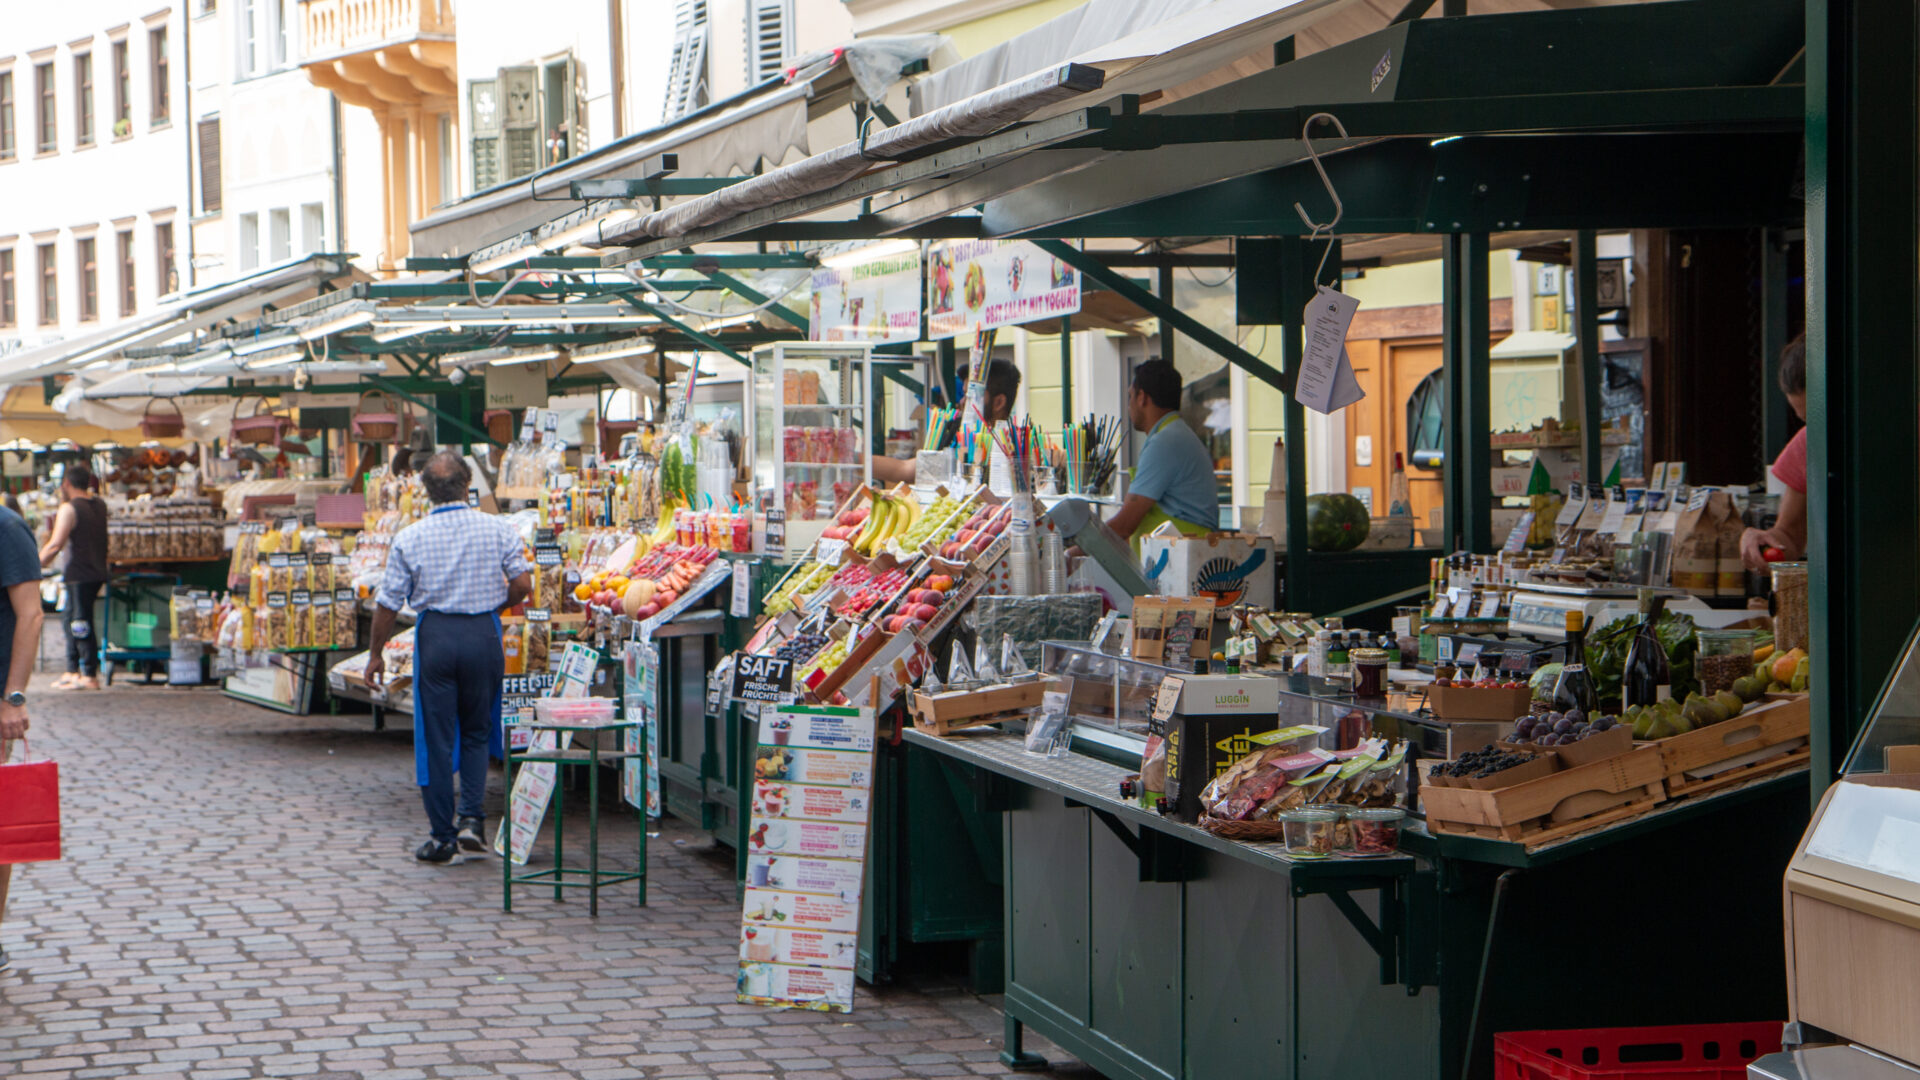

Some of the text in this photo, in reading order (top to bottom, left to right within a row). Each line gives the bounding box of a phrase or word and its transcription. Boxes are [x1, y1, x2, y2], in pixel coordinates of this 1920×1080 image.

[985, 288, 1078, 325] OBST SALAT MIT YOGURT
[489, 393, 514, 404] Nett
[738, 656, 789, 680] SAFT
[743, 681, 779, 692] FRISCHE
[741, 689, 778, 701] FRÜCHTE
[1215, 694, 1250, 704] LUGGIN
